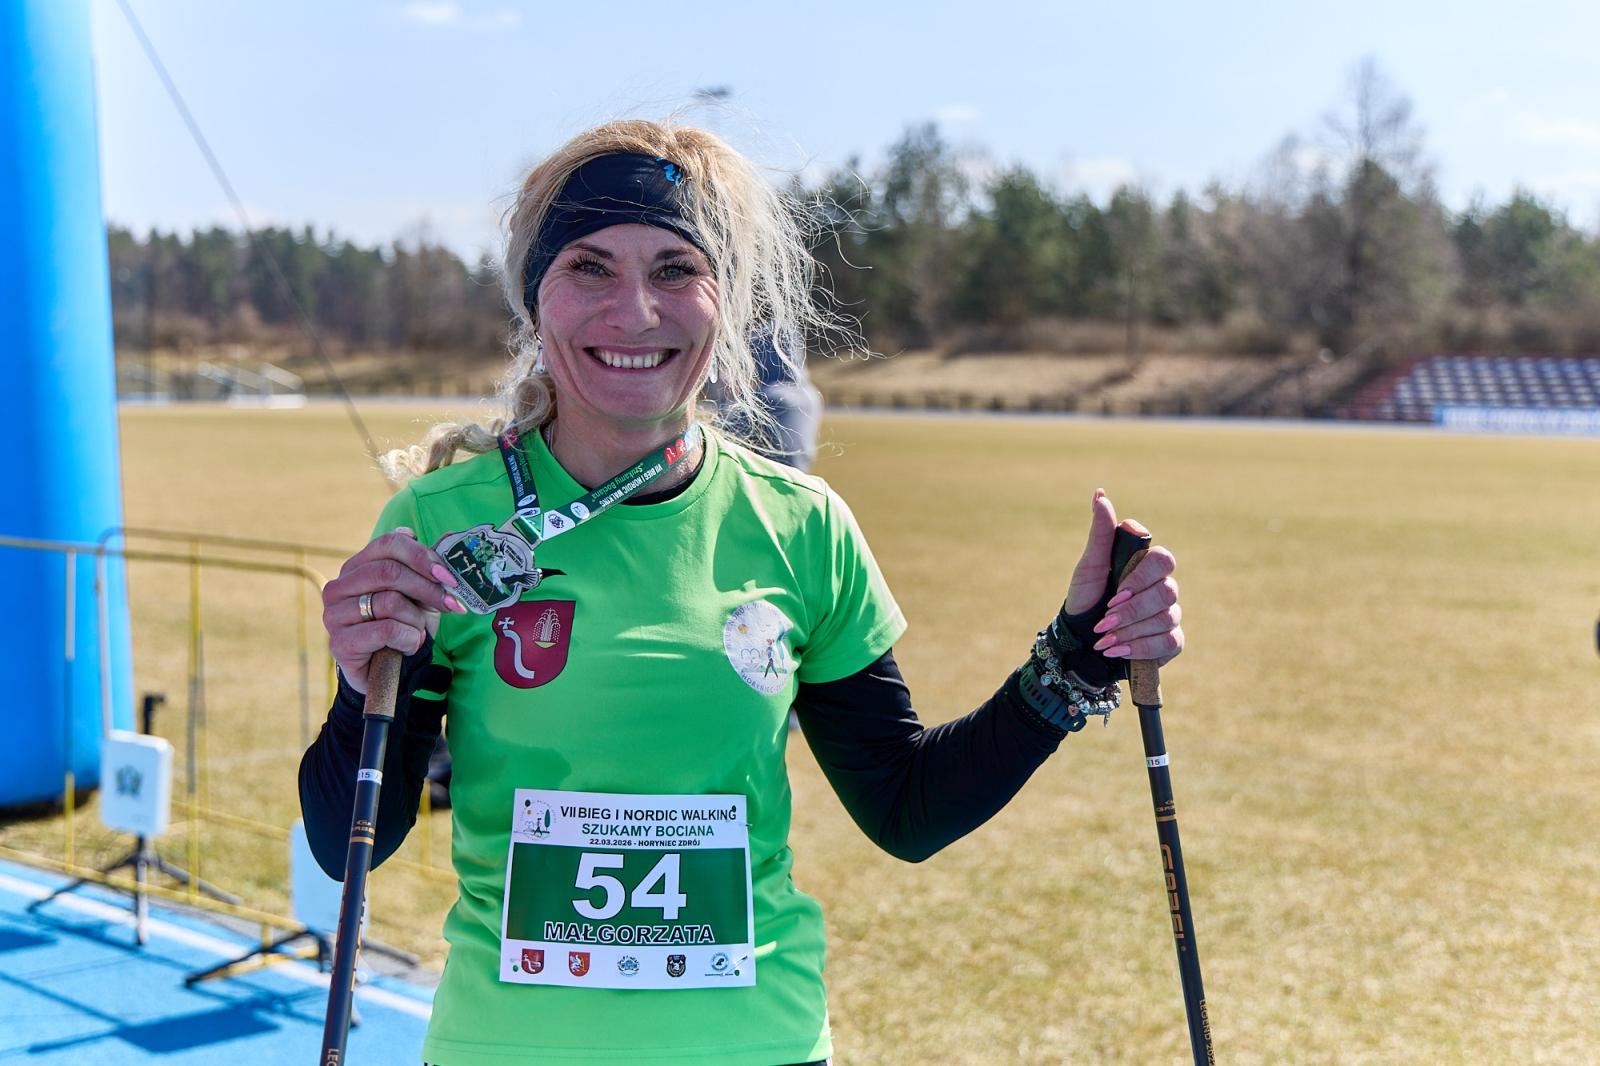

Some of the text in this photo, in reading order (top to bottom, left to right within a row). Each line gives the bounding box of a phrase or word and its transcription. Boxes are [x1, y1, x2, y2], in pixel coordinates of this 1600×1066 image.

[728, 605, 752, 626] NORDIC
[560, 806, 737, 821] VII BIEG I NORDIC WALKING
[581, 823, 715, 837] SZUKAMY BOCIANA
[589, 839, 632, 847] 22.03.2026
[678, 838, 700, 847] ZDRÓJ
[571, 852, 687, 921] 54
[544, 921, 715, 944] MAŁGORZATA
